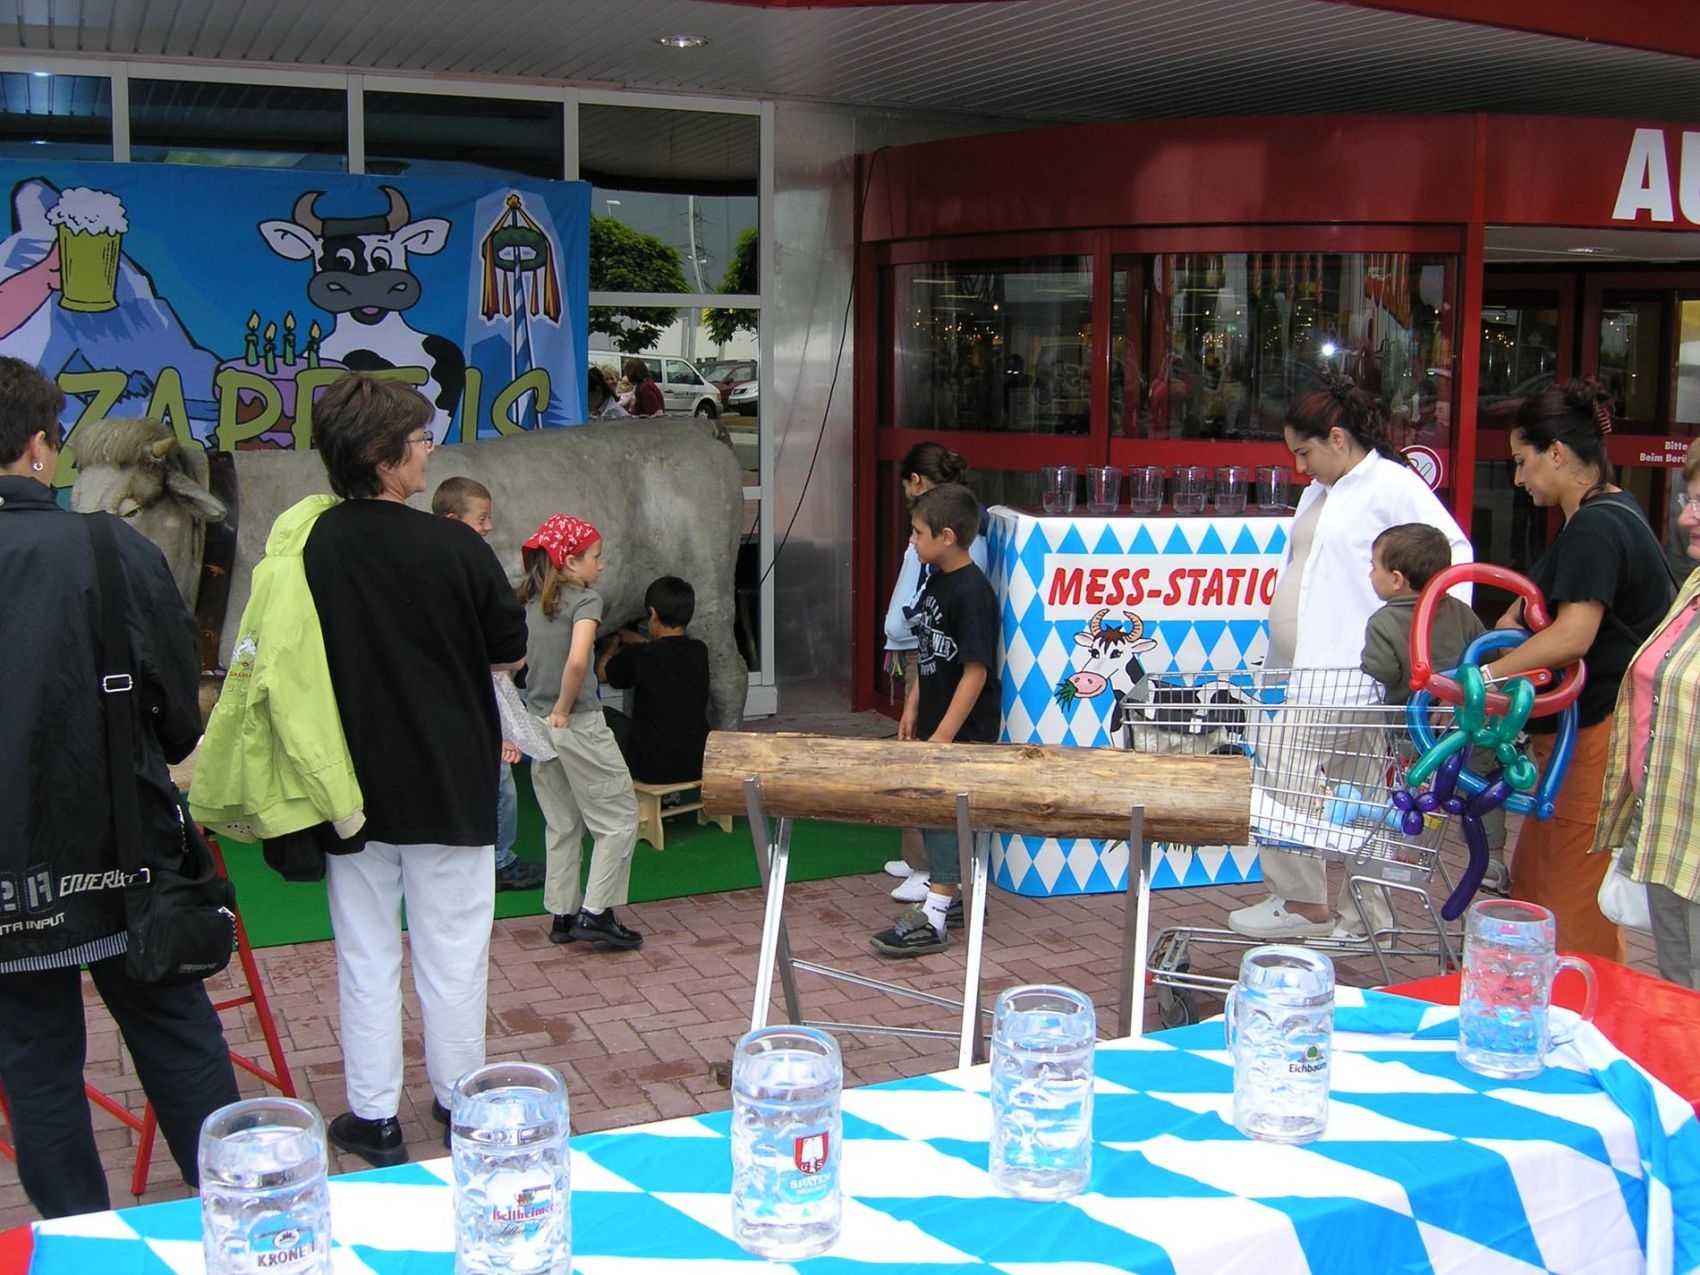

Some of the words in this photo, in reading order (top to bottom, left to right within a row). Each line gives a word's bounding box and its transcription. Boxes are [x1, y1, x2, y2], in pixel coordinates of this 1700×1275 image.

[52, 366, 428, 489] ZAP
[1664, 441, 1688, 451] Bitte
[1640, 452, 1663, 462] Beim
[25, 911, 65, 930] INPUT
